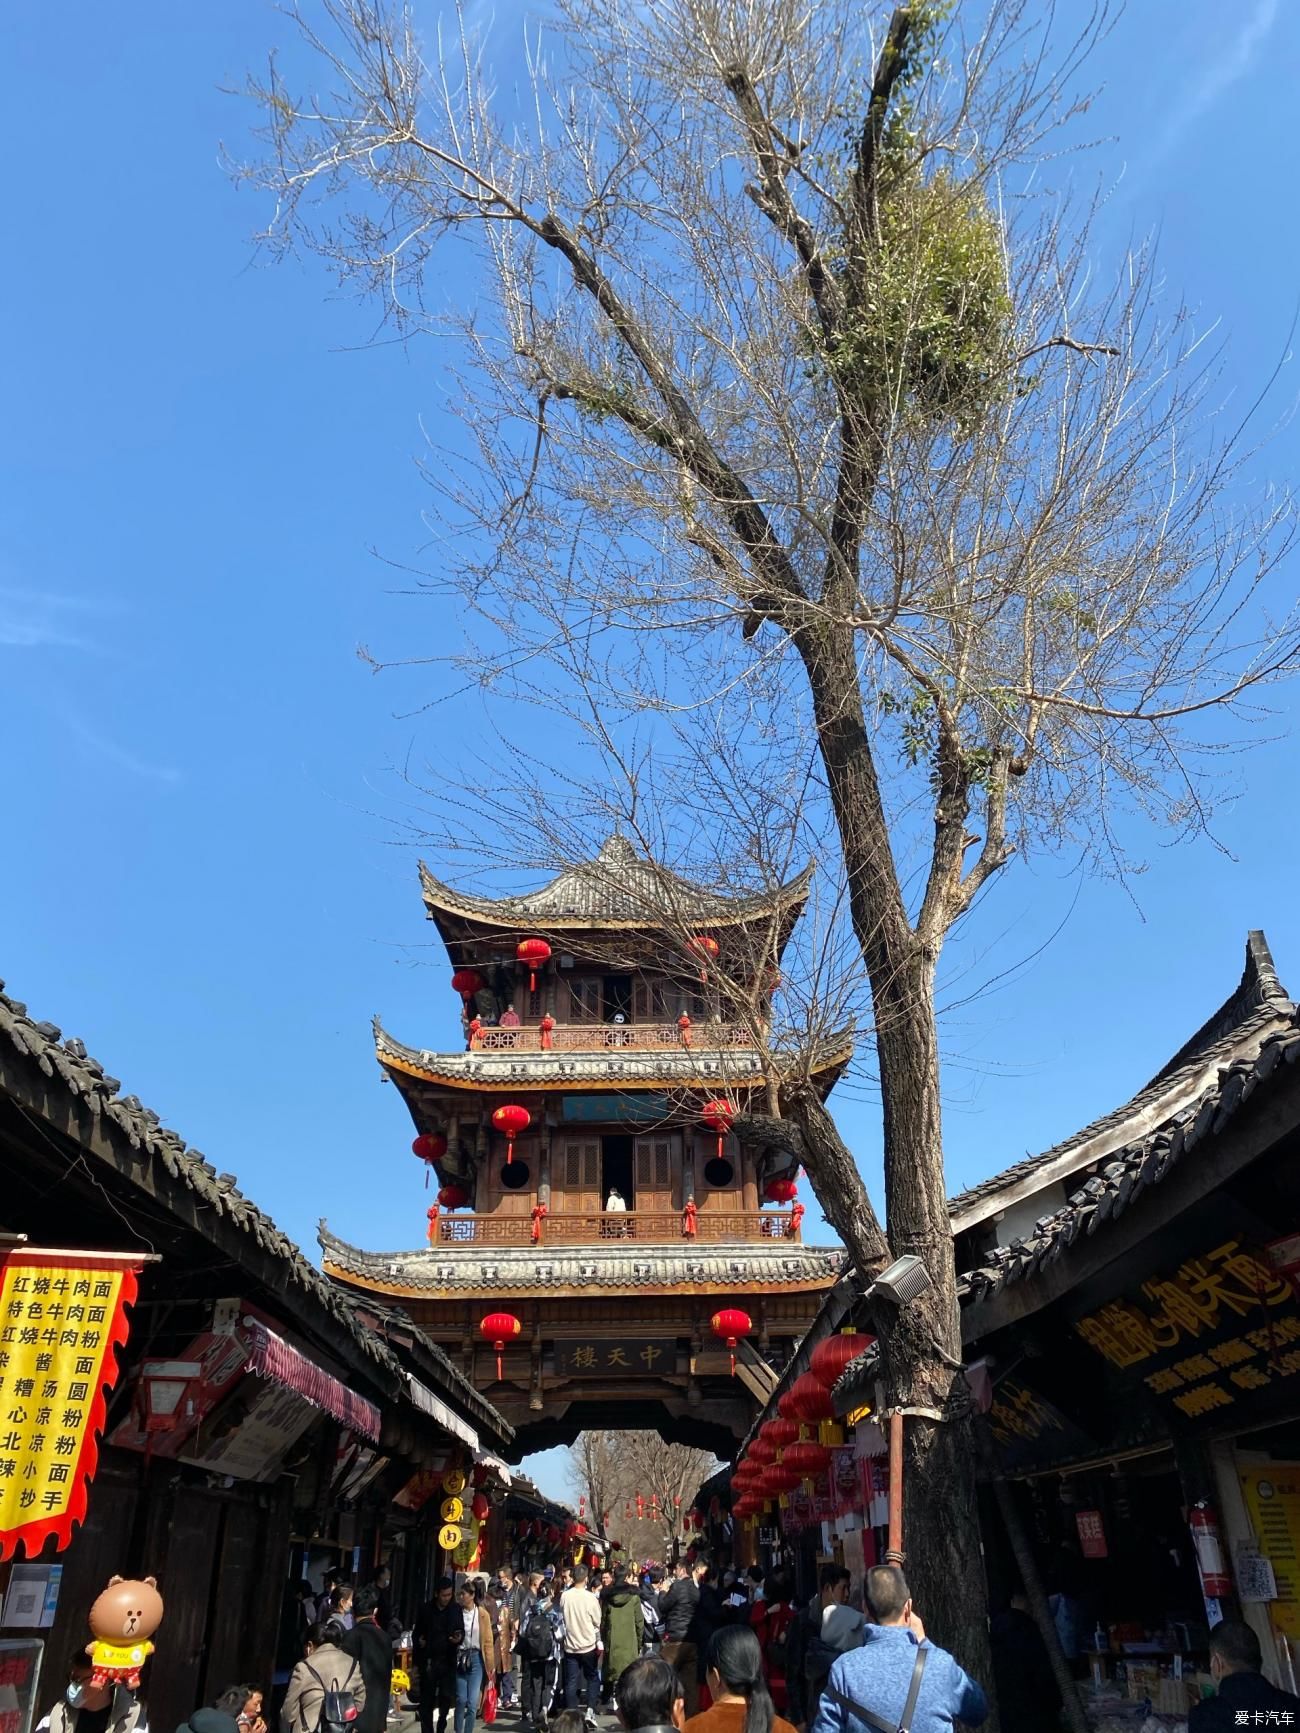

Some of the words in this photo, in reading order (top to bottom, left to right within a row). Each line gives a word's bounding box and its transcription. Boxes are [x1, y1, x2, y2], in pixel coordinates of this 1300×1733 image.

[12, 1276, 113, 1298] 红烧牛肉面
[7, 1300, 107, 1323] 特色牛肉面
[1, 1325, 100, 1349] 红烧牛肉粉
[0, 1377, 89, 1401] 糟汤圆
[7, 1406, 83, 1428] 心凉粉
[0, 1432, 77, 1455] 北凉粉
